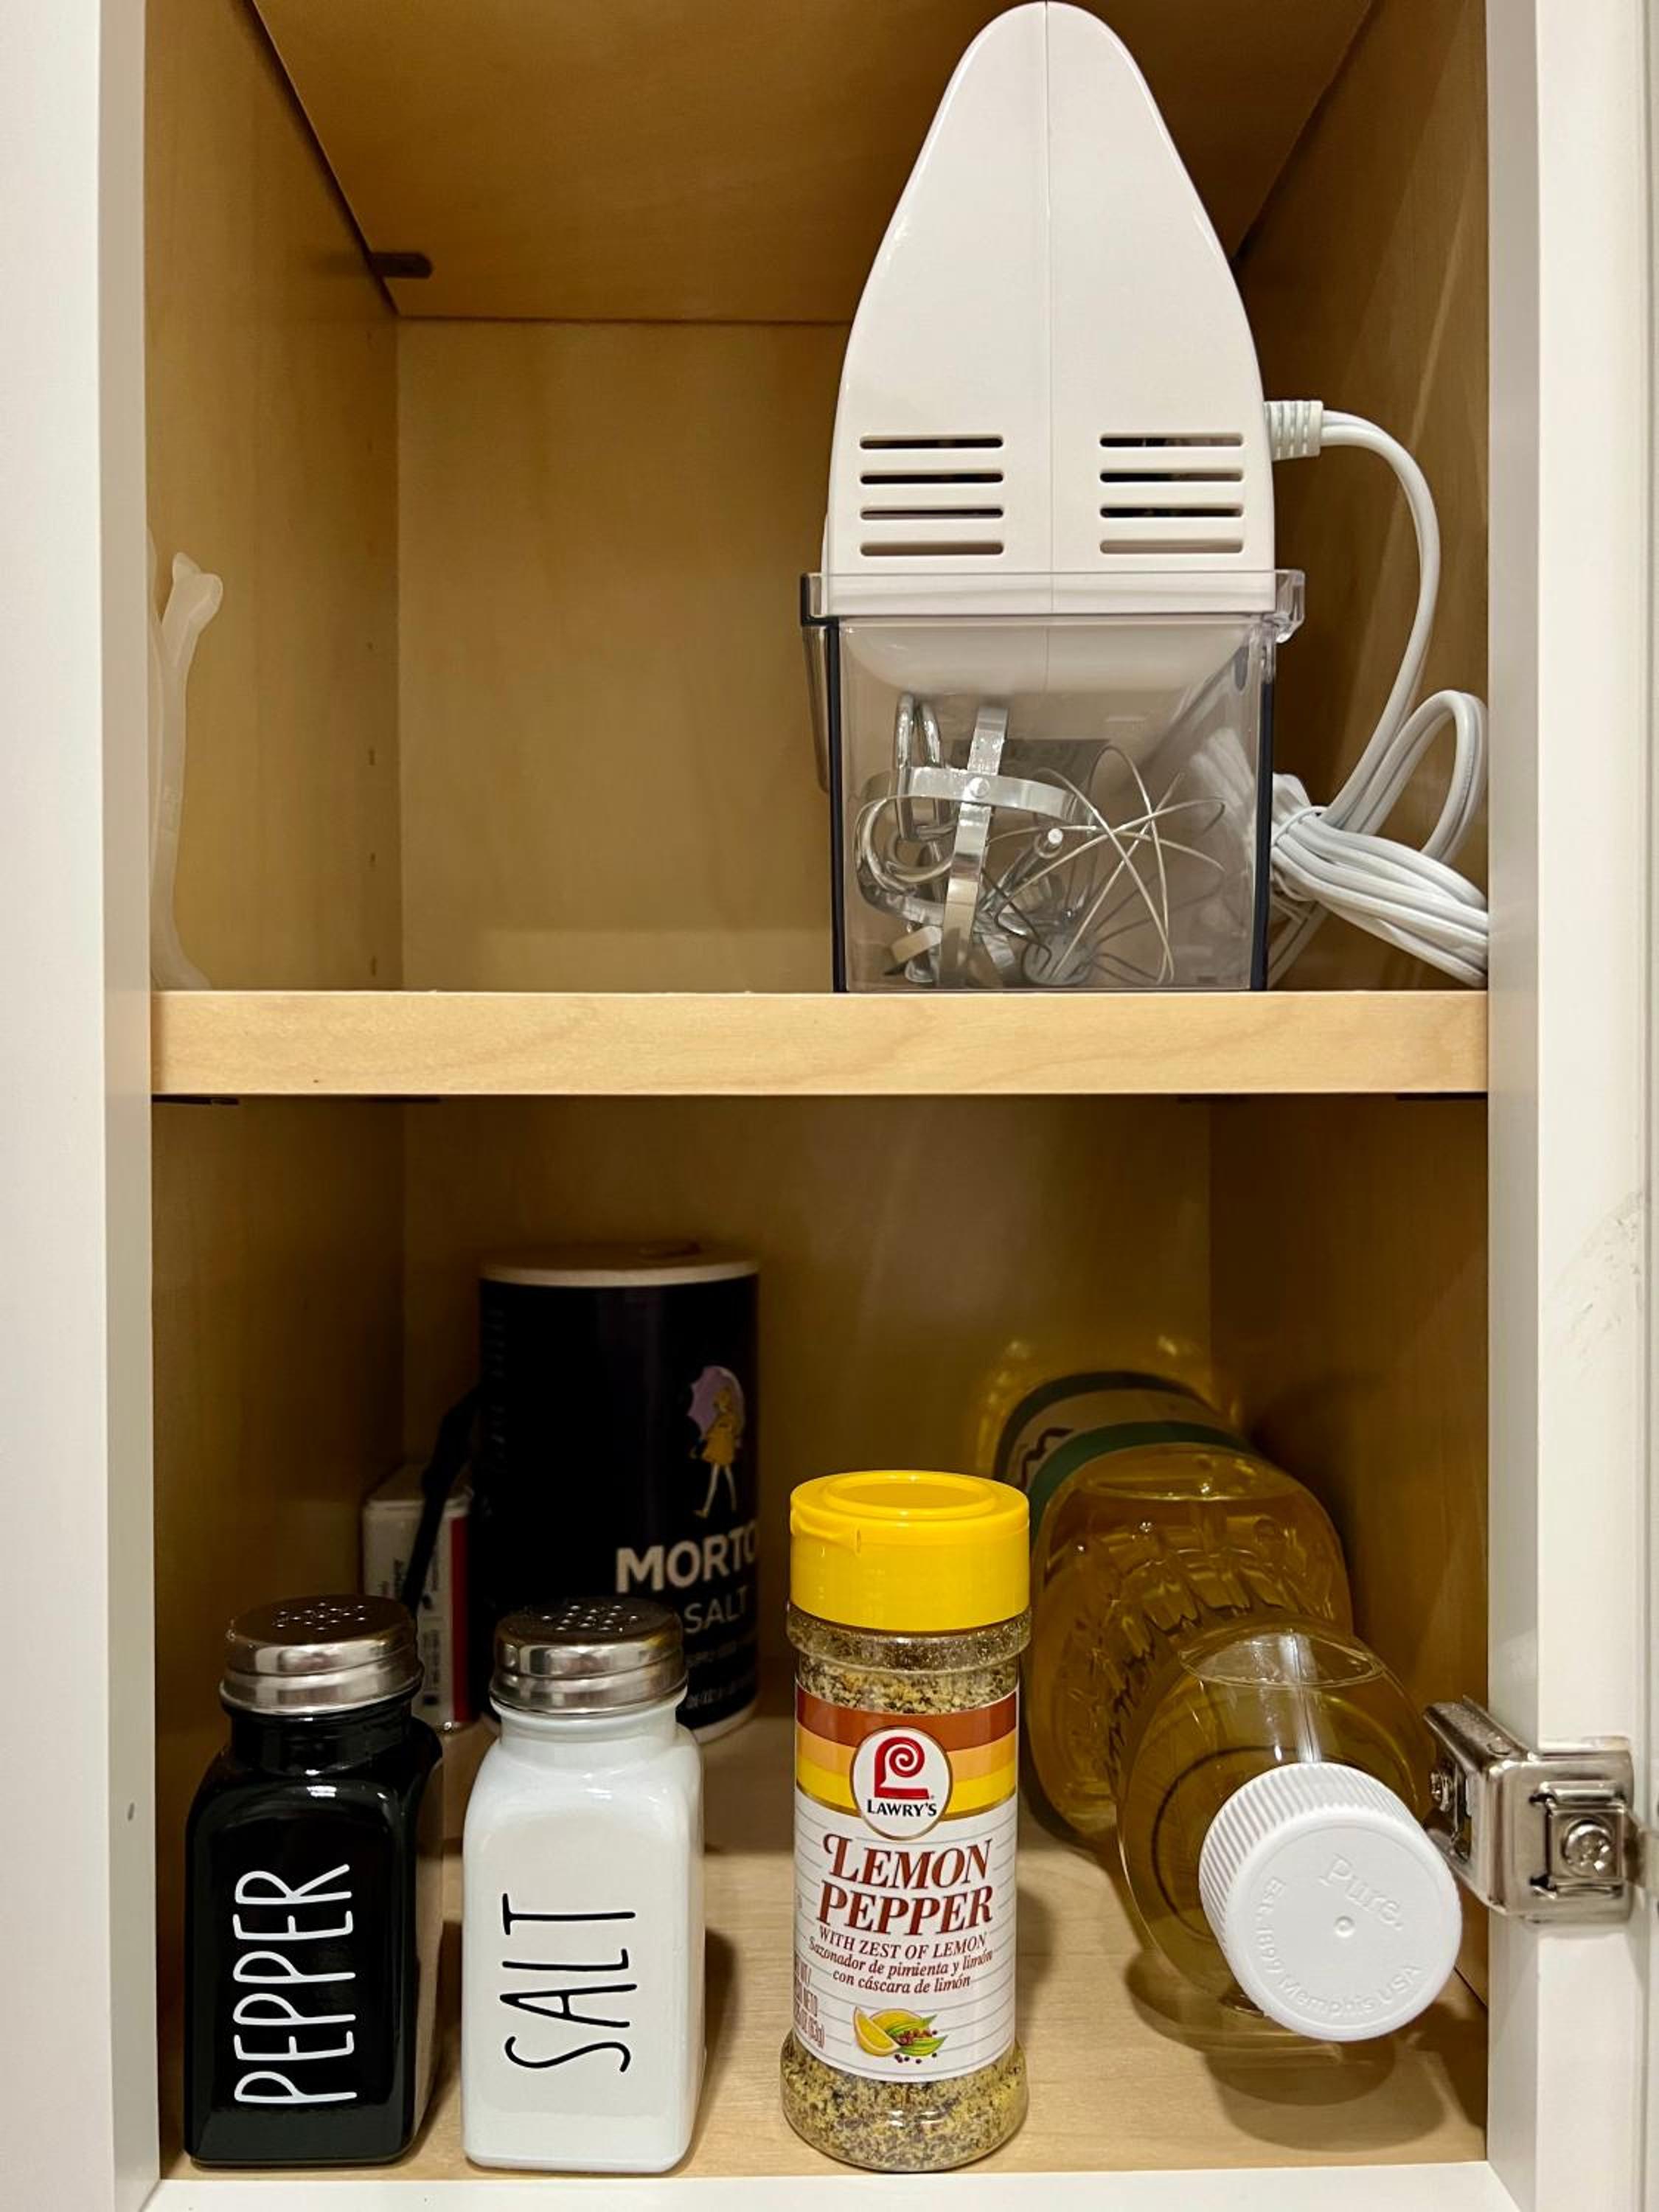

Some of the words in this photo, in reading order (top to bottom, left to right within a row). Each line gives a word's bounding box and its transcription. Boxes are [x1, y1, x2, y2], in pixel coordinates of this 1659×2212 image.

[684, 1585, 749, 1635] SALT
[867, 1800, 937, 1816] LAWRY'S
[823, 1833, 992, 1890] LEMON
[816, 1880, 993, 1935] PEPPER
[809, 1936, 866, 1971] Sazonador
[869, 1960, 885, 1974] de
[886, 1961, 948, 1979] pimienta
[951, 1964, 959, 1977] y
[962, 1949, 992, 1970] limón
[820, 1925, 855, 1952] WITH
[859, 1940, 901, 1959] ZEST
[905, 1944, 929, 1959] OF
[933, 1933, 987, 1958] LEMON
[233, 1864, 357, 2104] PEPPER
[499, 1893, 637, 2073] SALT
[832, 1970, 855, 1985] con
[858, 1977, 911, 1994] cáscara
[914, 1979, 931, 1994] de
[934, 1973, 971, 1992] limón
[1377, 1964, 1423, 2003] USA
